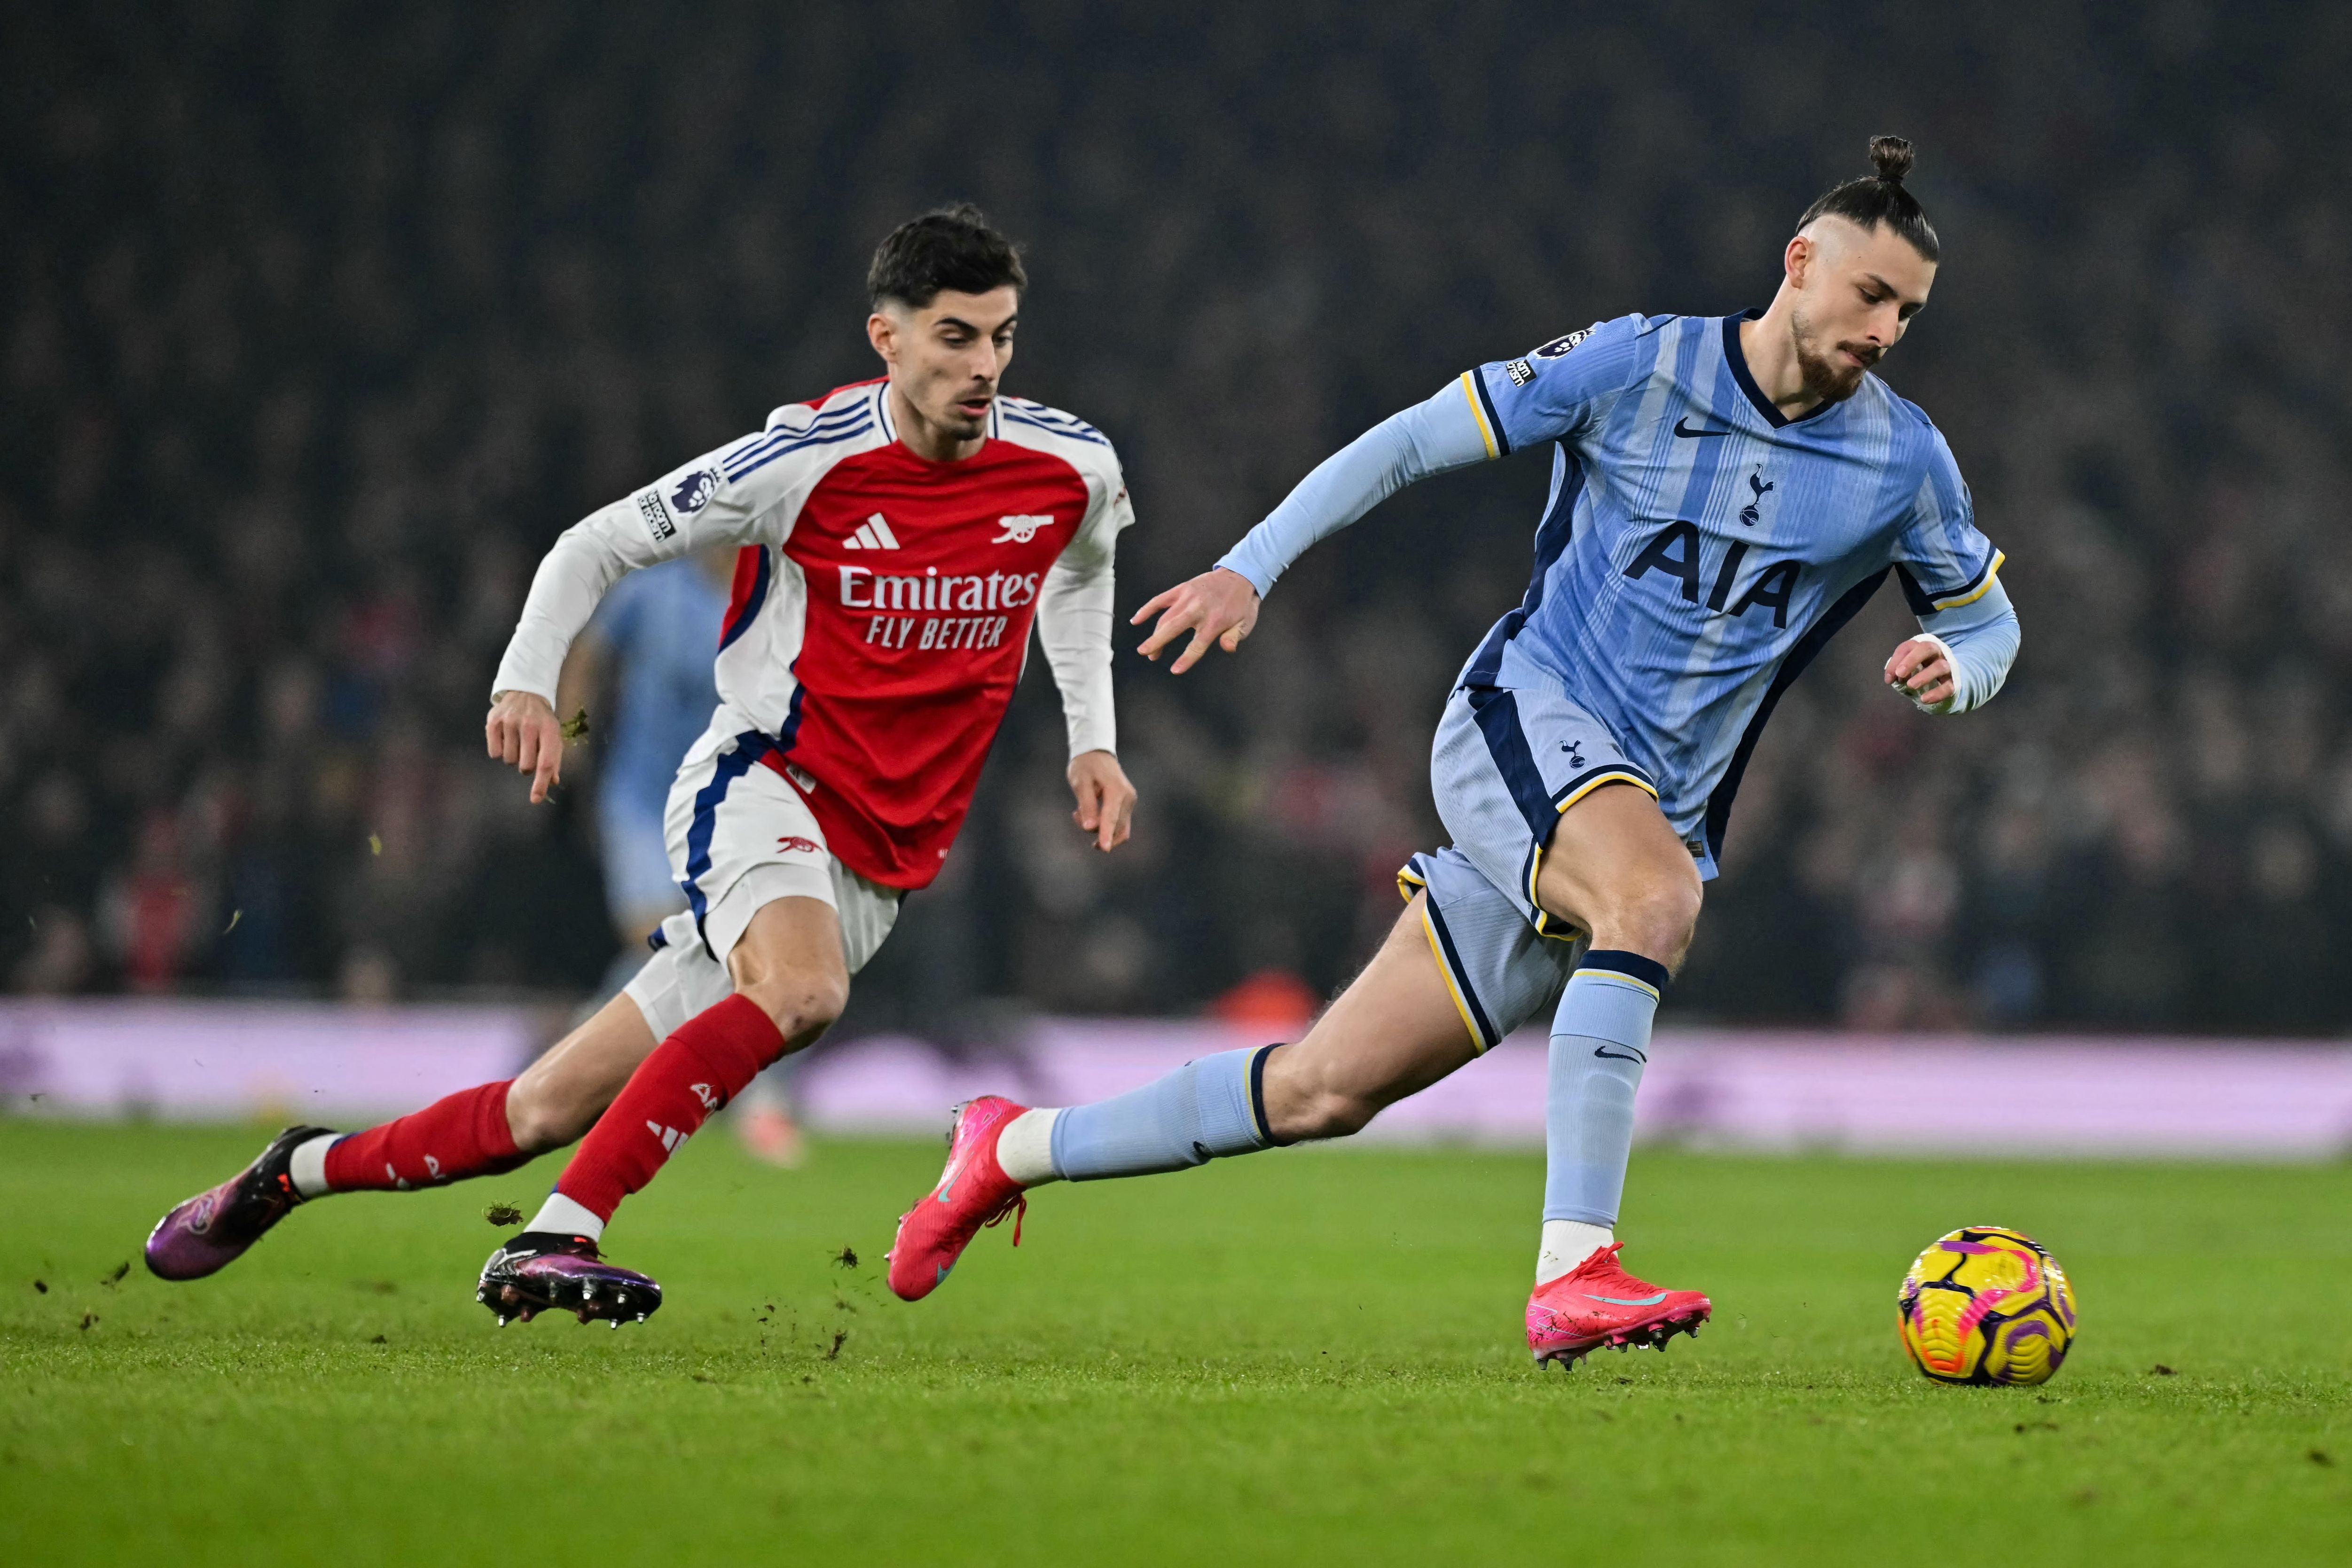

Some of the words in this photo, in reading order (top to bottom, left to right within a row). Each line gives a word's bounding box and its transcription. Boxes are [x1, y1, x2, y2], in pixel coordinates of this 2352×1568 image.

[651, 501, 672, 533] room
[839, 565, 1038, 611] Emirates
[1623, 520, 1801, 629] AIA
[866, 615, 916, 649] FLY
[918, 616, 1008, 651] BETTER
